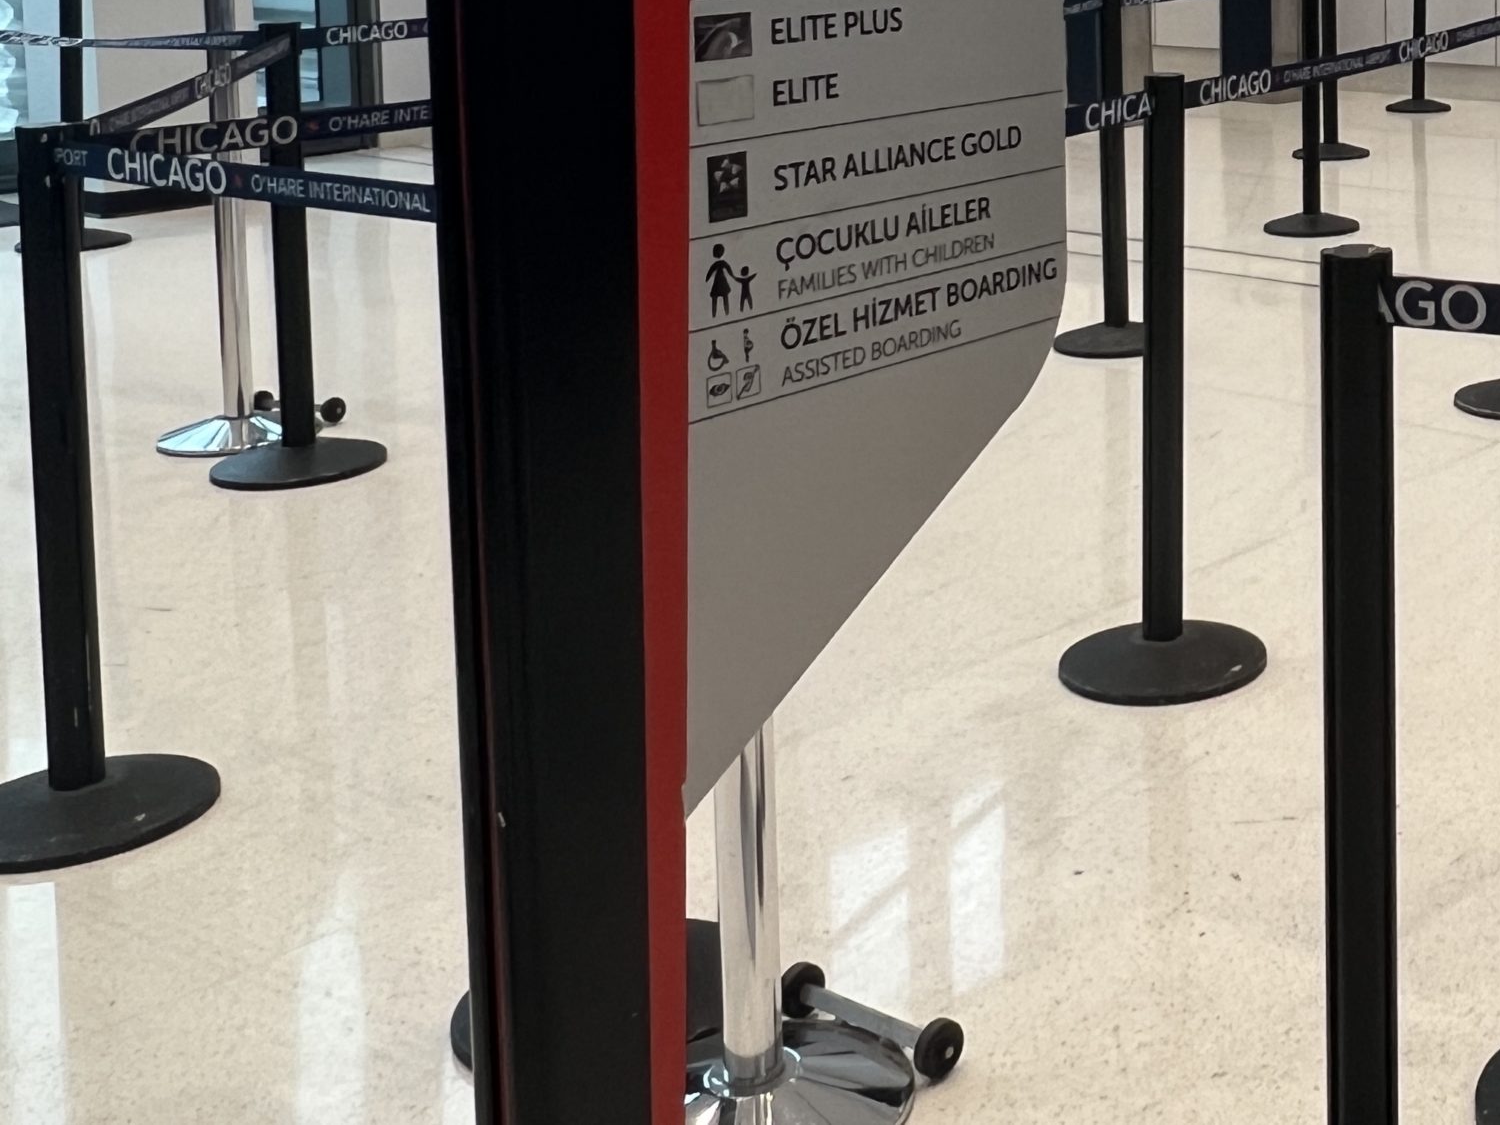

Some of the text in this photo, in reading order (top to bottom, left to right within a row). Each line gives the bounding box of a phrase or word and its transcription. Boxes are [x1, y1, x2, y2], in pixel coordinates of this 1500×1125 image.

[326, 21, 408, 46] CHICAGO
[771, 7, 903, 45] ELITE PLUS
[772, 72, 840, 107] ELITE
[1200, 69, 1272, 106] CHICAGO
[1400, 31, 1449, 63] CHICAGO
[129, 115, 297, 156] CHICAGO
[329, 108, 390, 132] O'HARE
[1085, 92, 1155, 130] CHICA
[107, 147, 226, 195] CHICAGO
[251, 174, 305, 198] O'HARE
[309, 180, 431, 213] INTERNATIONAL
[774, 125, 1022, 192] STAR ALLIANCE GOLD
[776, 196, 991, 272] ÇOCUKLU AİLELER
[777, 233, 994, 300] FAMILIES WITH CHILDREN
[780, 257, 1058, 350] ÖZEL HİZMET BOARDING
[782, 319, 961, 387] ASSISTED BOARDING
